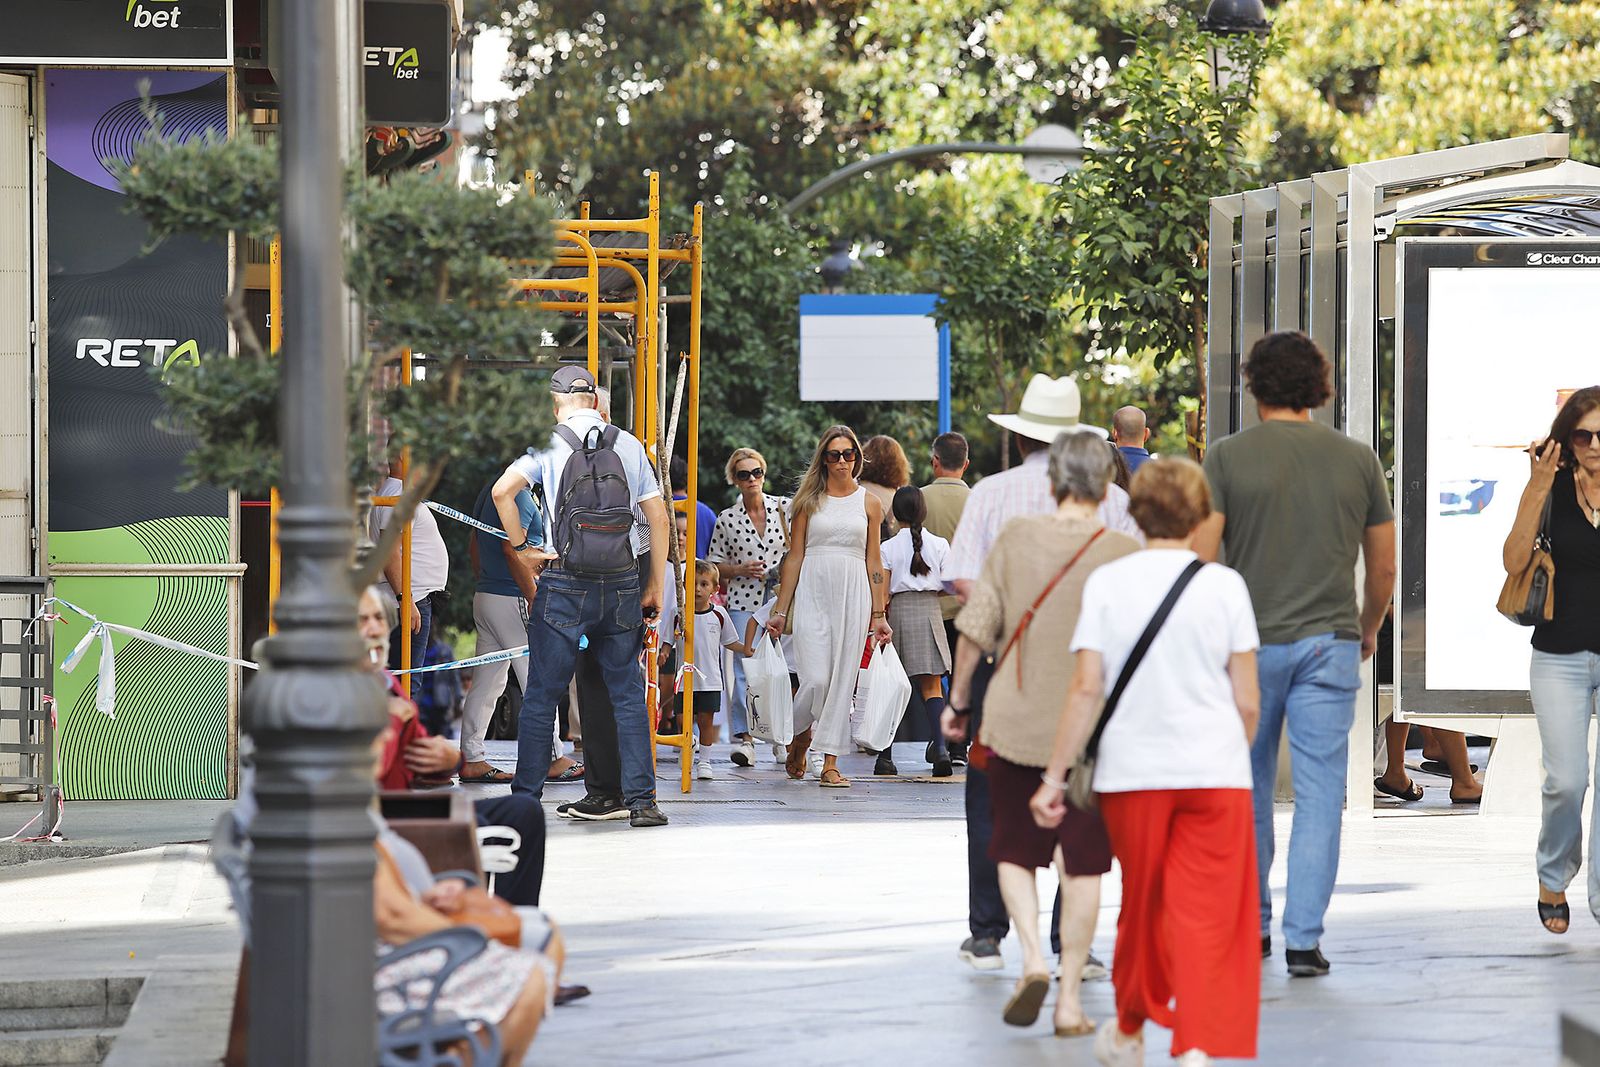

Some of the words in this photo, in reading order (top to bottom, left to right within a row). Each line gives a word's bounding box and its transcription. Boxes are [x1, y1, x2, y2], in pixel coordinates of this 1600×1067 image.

[134, 4, 181, 28] bet
[362, 46, 419, 75] ETA
[396, 67, 419, 79] bet
[1543, 254, 1571, 264] Clear
[75, 338, 200, 381] RETA
